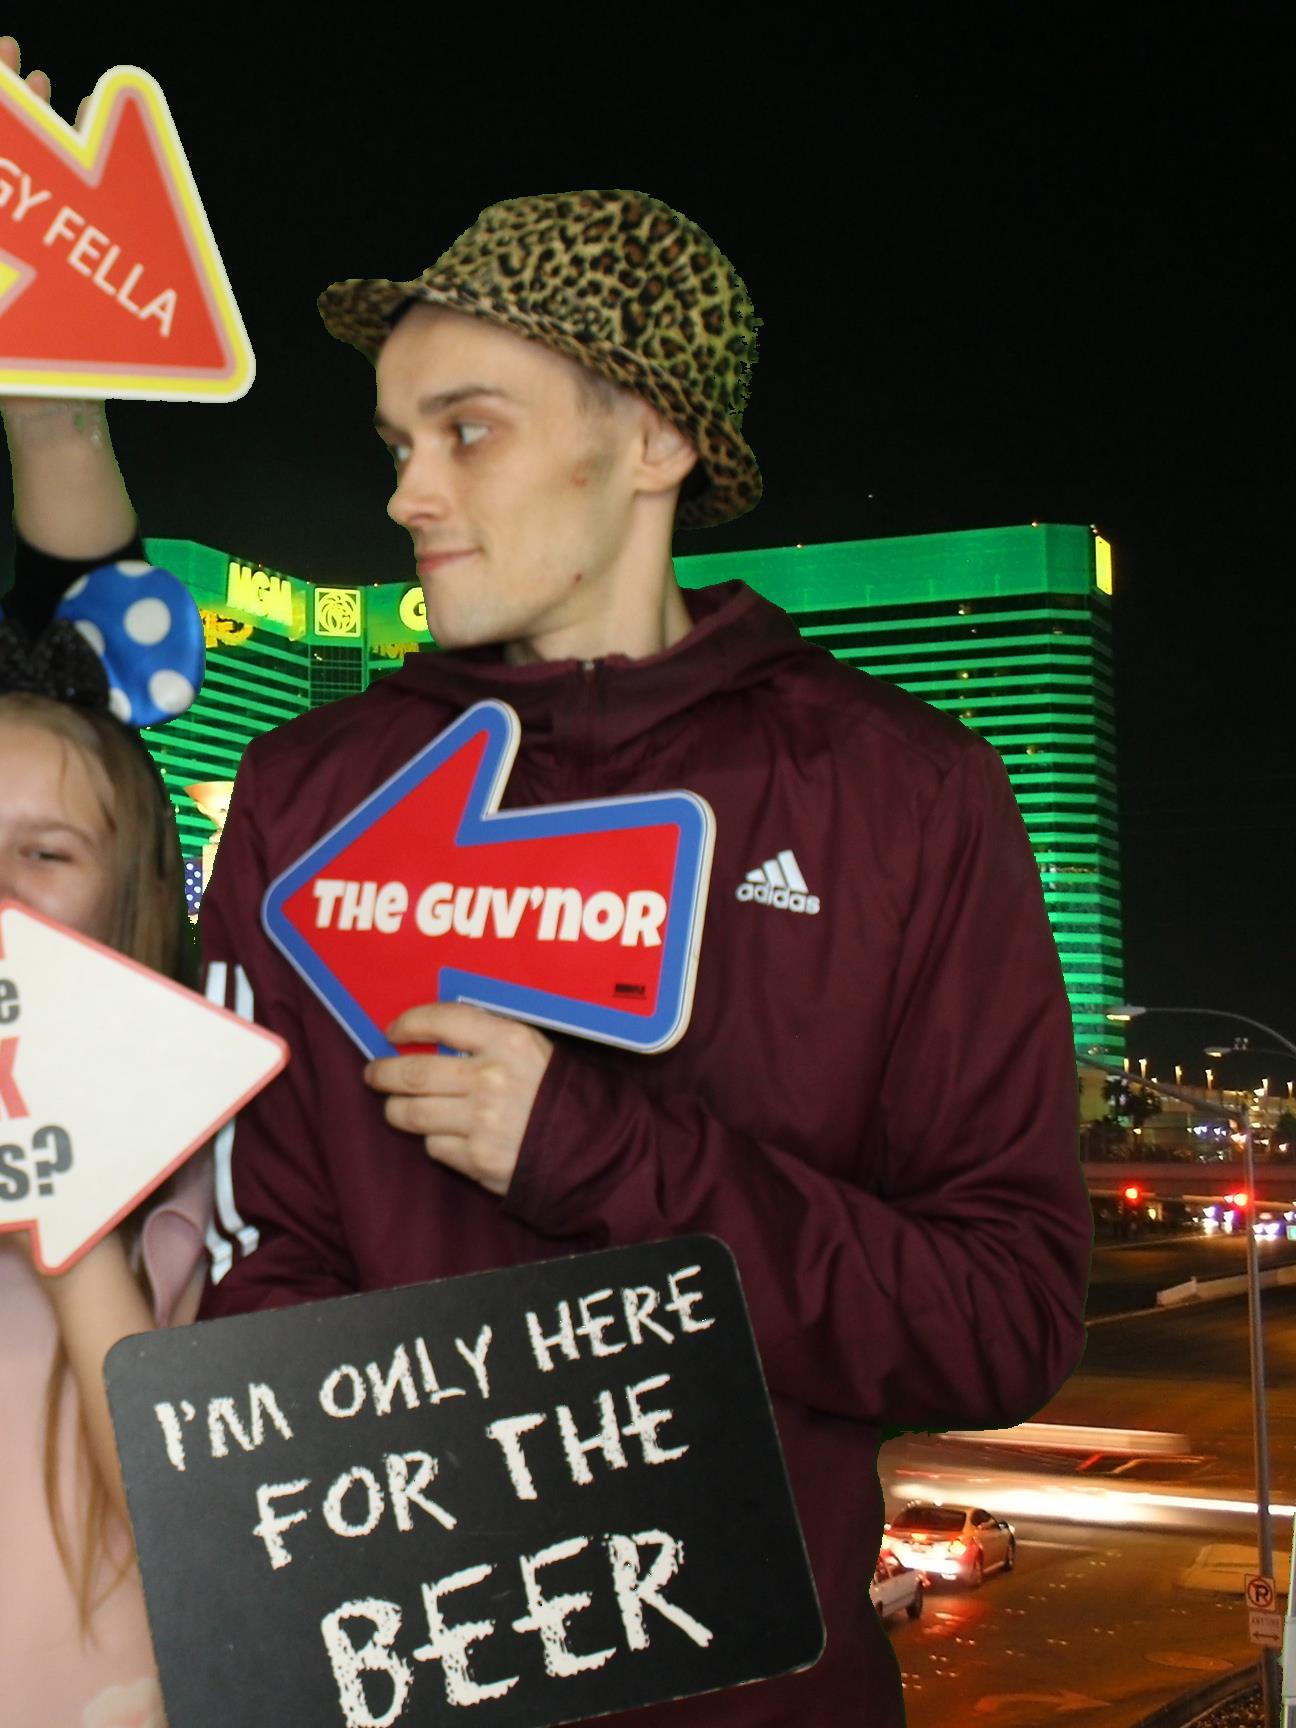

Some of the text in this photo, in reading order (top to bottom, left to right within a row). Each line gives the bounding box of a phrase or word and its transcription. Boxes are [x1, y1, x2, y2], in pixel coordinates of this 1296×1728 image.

[43, 206, 178, 338] FELLA
[227, 562, 293, 627] MGM
[735, 883, 821, 915] adidas
[154, 1265, 715, 1471] I'M ONLY HERE
[253, 1373, 690, 1570] FOR THE
[320, 1528, 714, 1728] BEER
